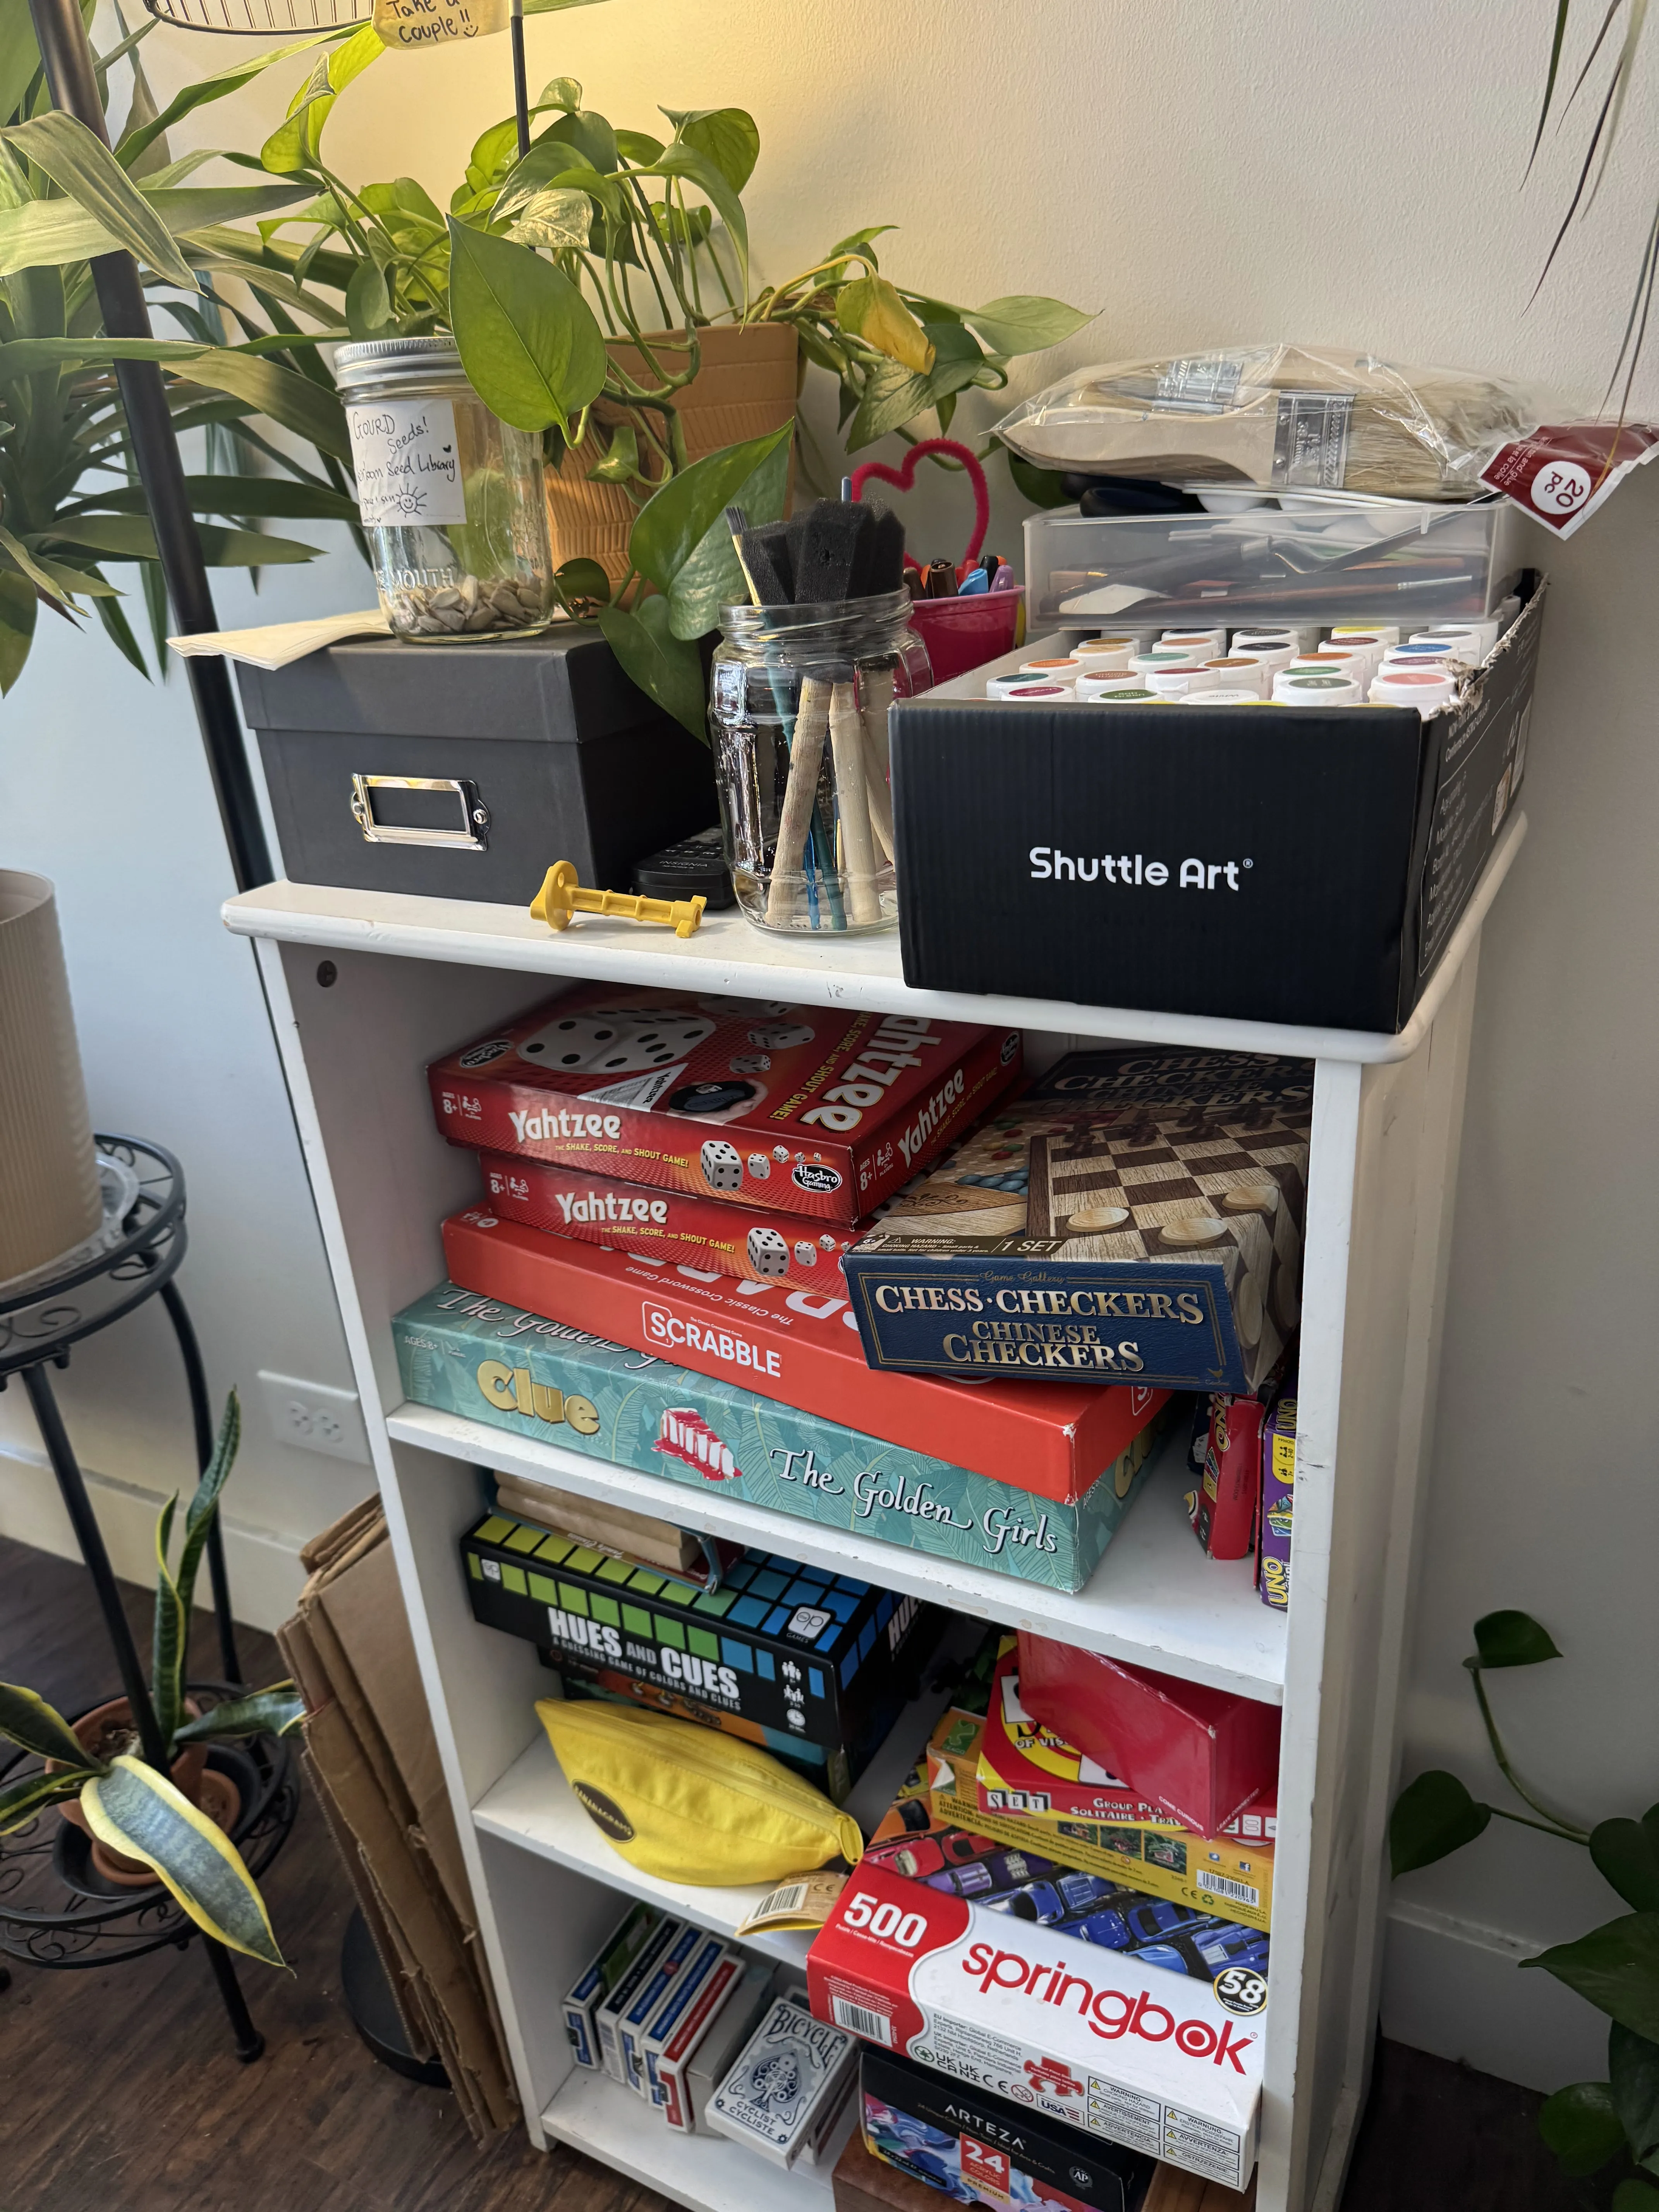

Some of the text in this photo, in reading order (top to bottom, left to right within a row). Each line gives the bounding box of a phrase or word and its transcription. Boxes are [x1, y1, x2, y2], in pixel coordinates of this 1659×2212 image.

[353, 412, 395, 440] GOURD
[388, 416, 429, 454] Seeds!
[386, 454, 455, 482] Seed Library
[1494, 463, 1509, 480] colle
[1516, 457, 1528, 473] and
[1504, 470, 1518, 486] glue
[1544, 471, 1563, 494] pc
[1556, 478, 1583, 508] 20
[1029, 847, 1169, 886] Shuttle
[769, 1029, 862, 1120] SCORE, AND SHOUT GAME!
[1117, 1053, 1279, 1075] CHESS
[1036, 1085, 1312, 1114] CHECKERS
[1087, 1079, 1266, 1100] CHINESE
[443, 1098, 458, 1114] 8+
[508, 1108, 622, 1144] Yahtzee
[897, 1068, 965, 1169] Yahtzee
[566, 1142, 592, 1152] SHAKE,
[593, 1143, 620, 1154] SCORE,
[634, 1147, 661, 1160] SHOUT
[662, 1153, 689, 1168] GAME!
[860, 1158, 870, 1171] AGES
[795, 1165, 838, 1183] Hasbro
[802, 1176, 831, 1192] Gaming
[860, 1171, 873, 1191] 8+
[491, 1179, 505, 1194] 8+
[555, 1190, 668, 1224] Yahtzee
[612, 1226, 638, 1236] SHAKE,
[639, 1227, 666, 1238] SCORE,
[680, 1232, 707, 1245] SHOUT
[708, 1238, 735, 1254] GAME!
[1003, 1240, 1061, 1252] 1 SET
[979, 1270, 1066, 1284] Game Gallery
[436, 1288, 505, 1322] The
[625, 1266, 794, 1326] The Classic Crossword Game
[875, 1285, 1204, 1324] CHESS CHECKERS
[405, 1335, 438, 1350] AGES 8+
[971, 1320, 1101, 1345] CHINESE
[650, 1311, 782, 1378] SCRABBLE
[942, 1333, 1144, 1372] CHECKERS
[477, 1359, 600, 1435] Clue
[1276, 1398, 1297, 1432] UNO
[769, 1447, 1058, 1555] The Golden Girls
[1262, 1556, 1288, 1607] UNO
[786, 1632, 809, 1644] GAMES
[547, 1606, 740, 1699] HUES AND CUES
[559, 1637, 606, 1662] GUESSING
[607, 1654, 634, 1672] GAME
[635, 1666, 647, 1676] OF
[649, 1670, 686, 1691] COLORS
[688, 1685, 708, 1699] AND
[710, 1691, 741, 1711] CLUES
[1014, 1738, 1035, 1749] OF
[990, 1793, 1039, 1811] SET
[1070, 1806, 1135, 1821] SOLITAIRE
[1092, 1797, 1165, 1814] GROUP PLA
[1216, 1788, 1259, 1832] LEAVE CONNECTED
[1158, 1796, 1204, 1832] COME CURIOUS
[844, 1892, 927, 1948] 500
[1218, 1970, 1265, 2004] 58
[763, 2003, 848, 2070] BICYCLE
[943, 2016, 968, 2029] Importer:
[969, 2027, 986, 2037] Global
[987, 2034, 1022, 2051] E-Commerce
[936, 2052, 956, 2066] UK
[943, 2035, 968, 2047] Importer:
[969, 2045, 986, 2055] Global
[987, 2052, 1022, 2069] E-Commerce
[987, 2045, 1019, 2061] Netherlands
[1004, 2046, 1015, 2054] Unit
[937, 2060, 957, 2074] CA
[958, 2061, 979, 2075] UK
[960, 2069, 981, 2083] NI
[1103, 2088, 1151, 2109] CHOKING HAZARD
[1110, 2086, 1143, 2102] WARNING:
[737, 2101, 776, 2125] CYCLIST
[1041, 2099, 1066, 2116] USA
[1103, 2104, 1151, 2125] AVERTISSEMENT:
[729, 2106, 775, 2135] CYCLISTE
[945, 2104, 1025, 2150] ARTEZA
[1187, 2116, 1224, 2135] WARNUNG:
[965, 2140, 1005, 2174] 24
[1179, 2134, 1229, 2157] AVVERTENZA:
[969, 2161, 1001, 2181] ACRYLIC
[969, 2167, 1001, 2186] COLORS
[1073, 2170, 1088, 2182] AP
[967, 2178, 1005, 2200] PREMIUM
